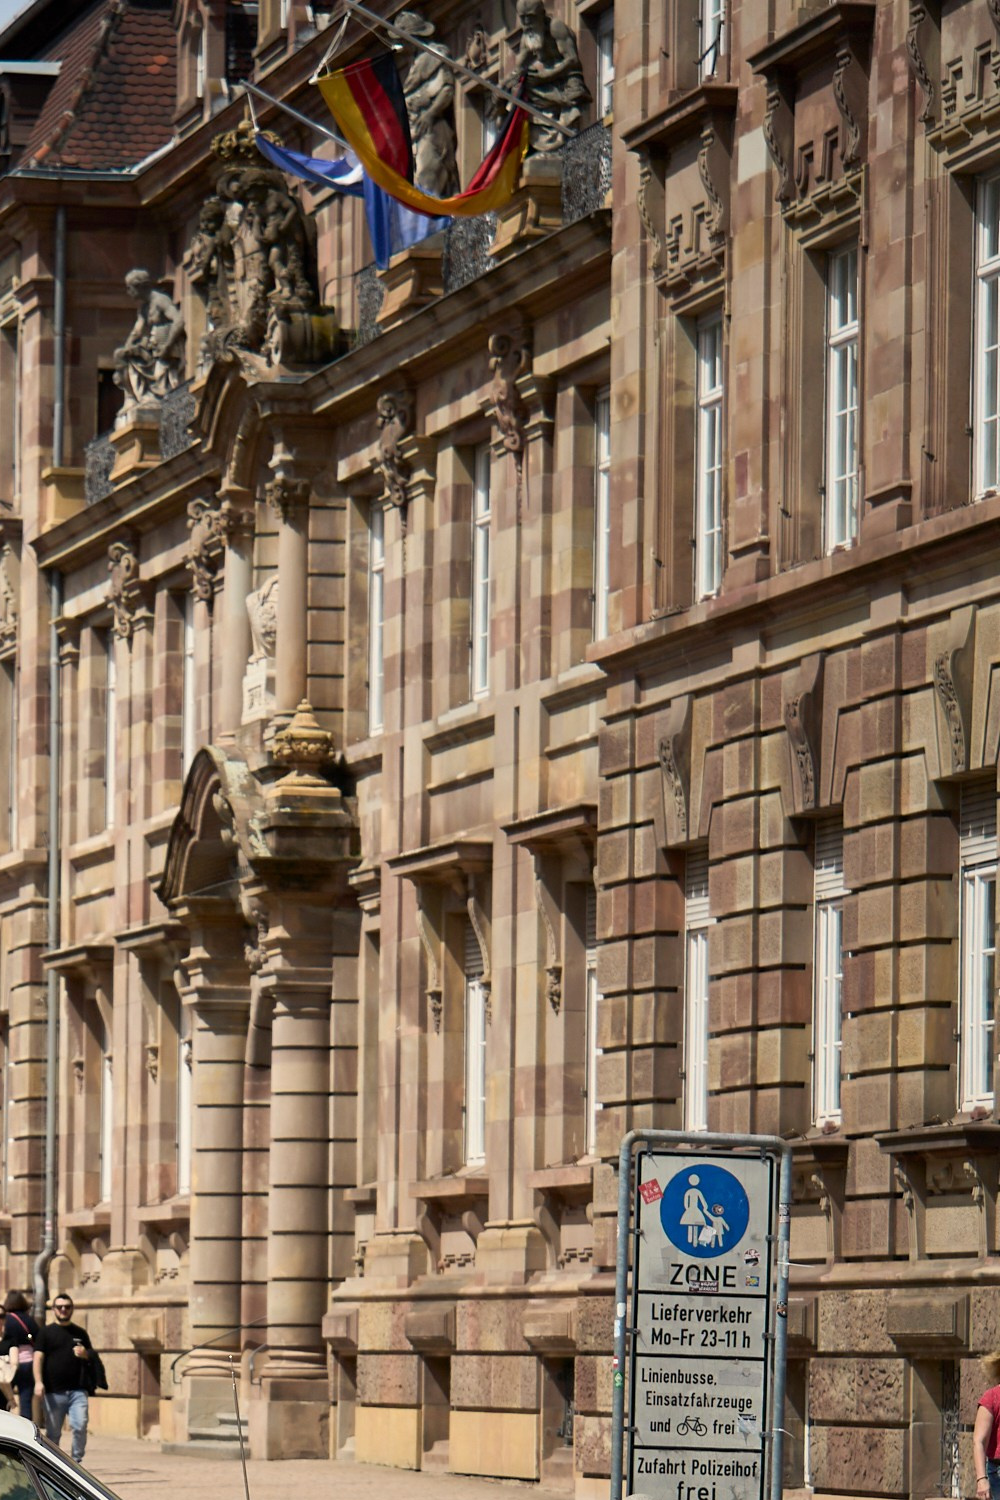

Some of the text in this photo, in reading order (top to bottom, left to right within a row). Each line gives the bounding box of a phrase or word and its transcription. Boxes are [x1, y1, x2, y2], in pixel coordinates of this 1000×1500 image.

[669, 1263, 737, 1287] ZONE
[651, 1302, 752, 1323] Lieferverkehr
[651, 1327, 696, 1346] Mo-Fr
[700, 1329, 737, 1348] 23-11
[641, 1368, 717, 1386] Linienbusse,
[645, 1391, 752, 1412] Einsatzfahrzeuge
[650, 1418, 736, 1435] und frei
[637, 1457, 758, 1477] Zufahrt Polizeihof
